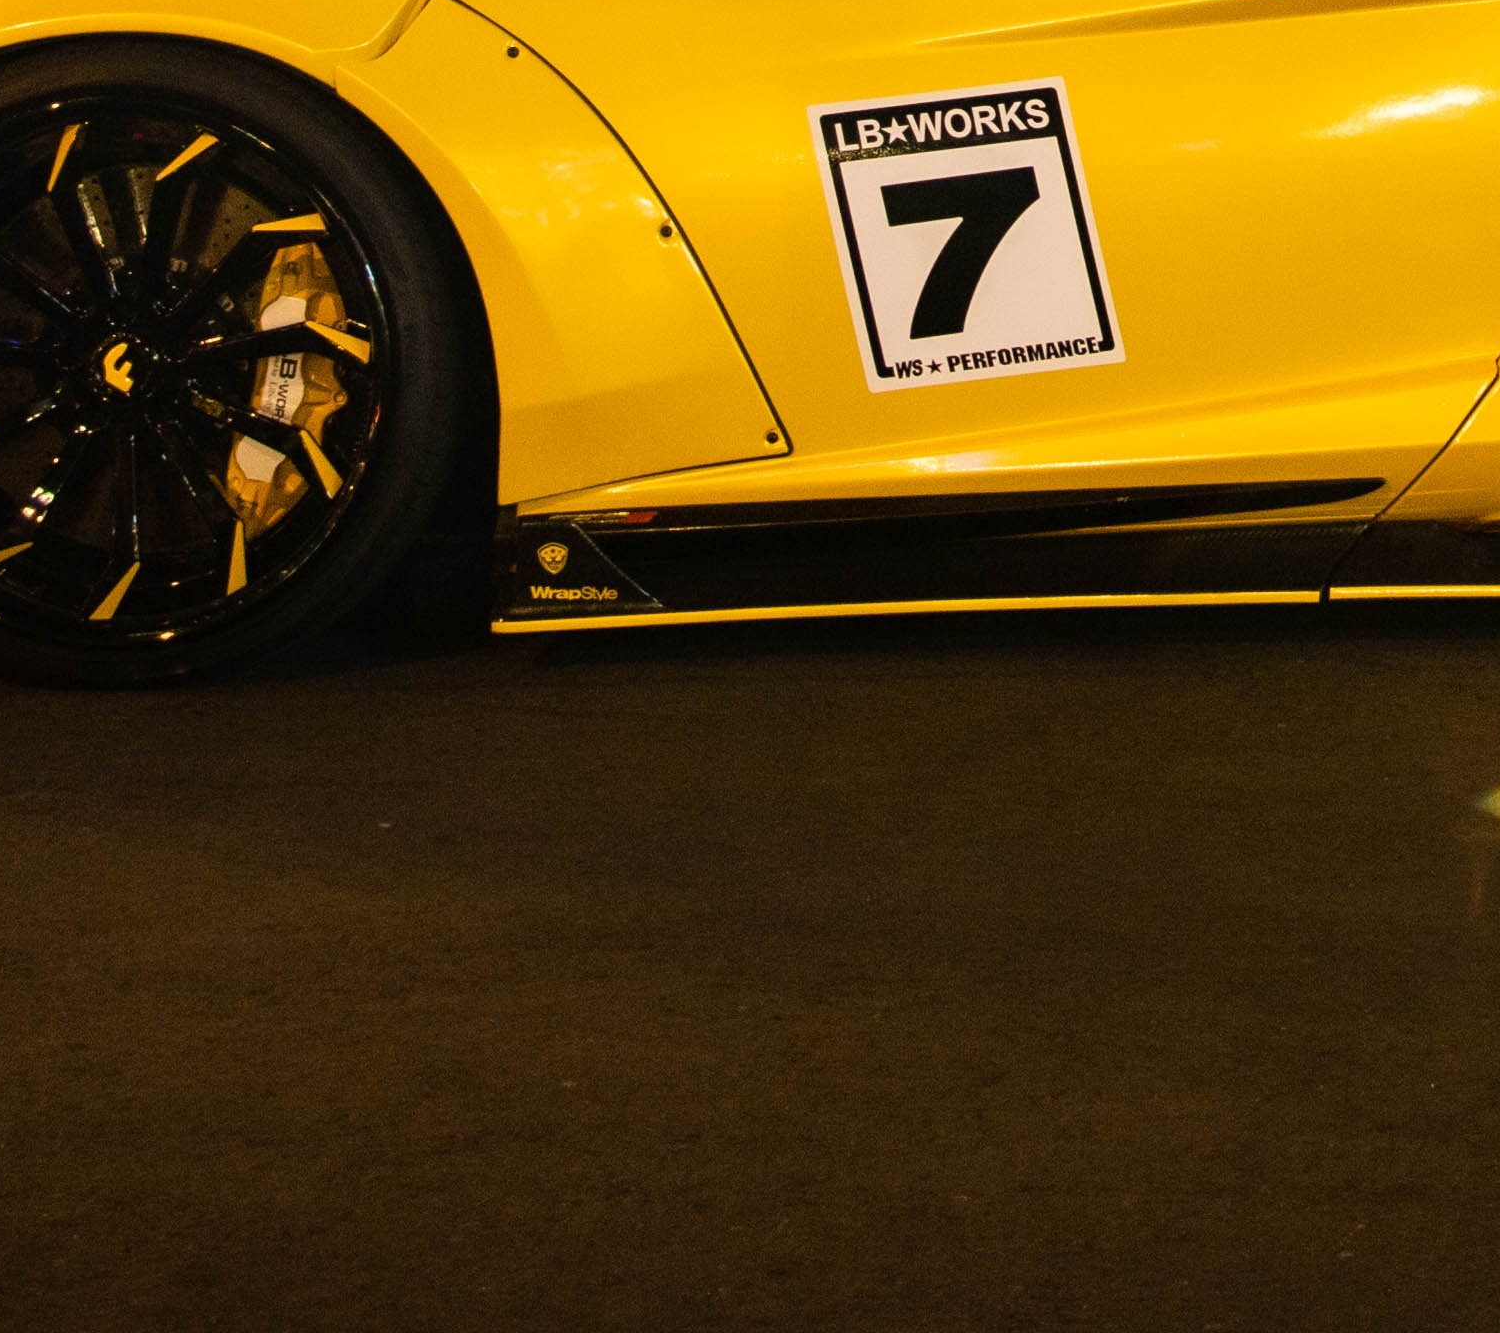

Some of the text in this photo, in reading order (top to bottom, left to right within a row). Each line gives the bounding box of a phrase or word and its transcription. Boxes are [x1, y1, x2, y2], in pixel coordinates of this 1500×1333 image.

[880, 166, 1041, 340] 7
[895, 336, 1100, 379] WS PERFORMANCE
[530, 586, 619, 601] WrapStyle
